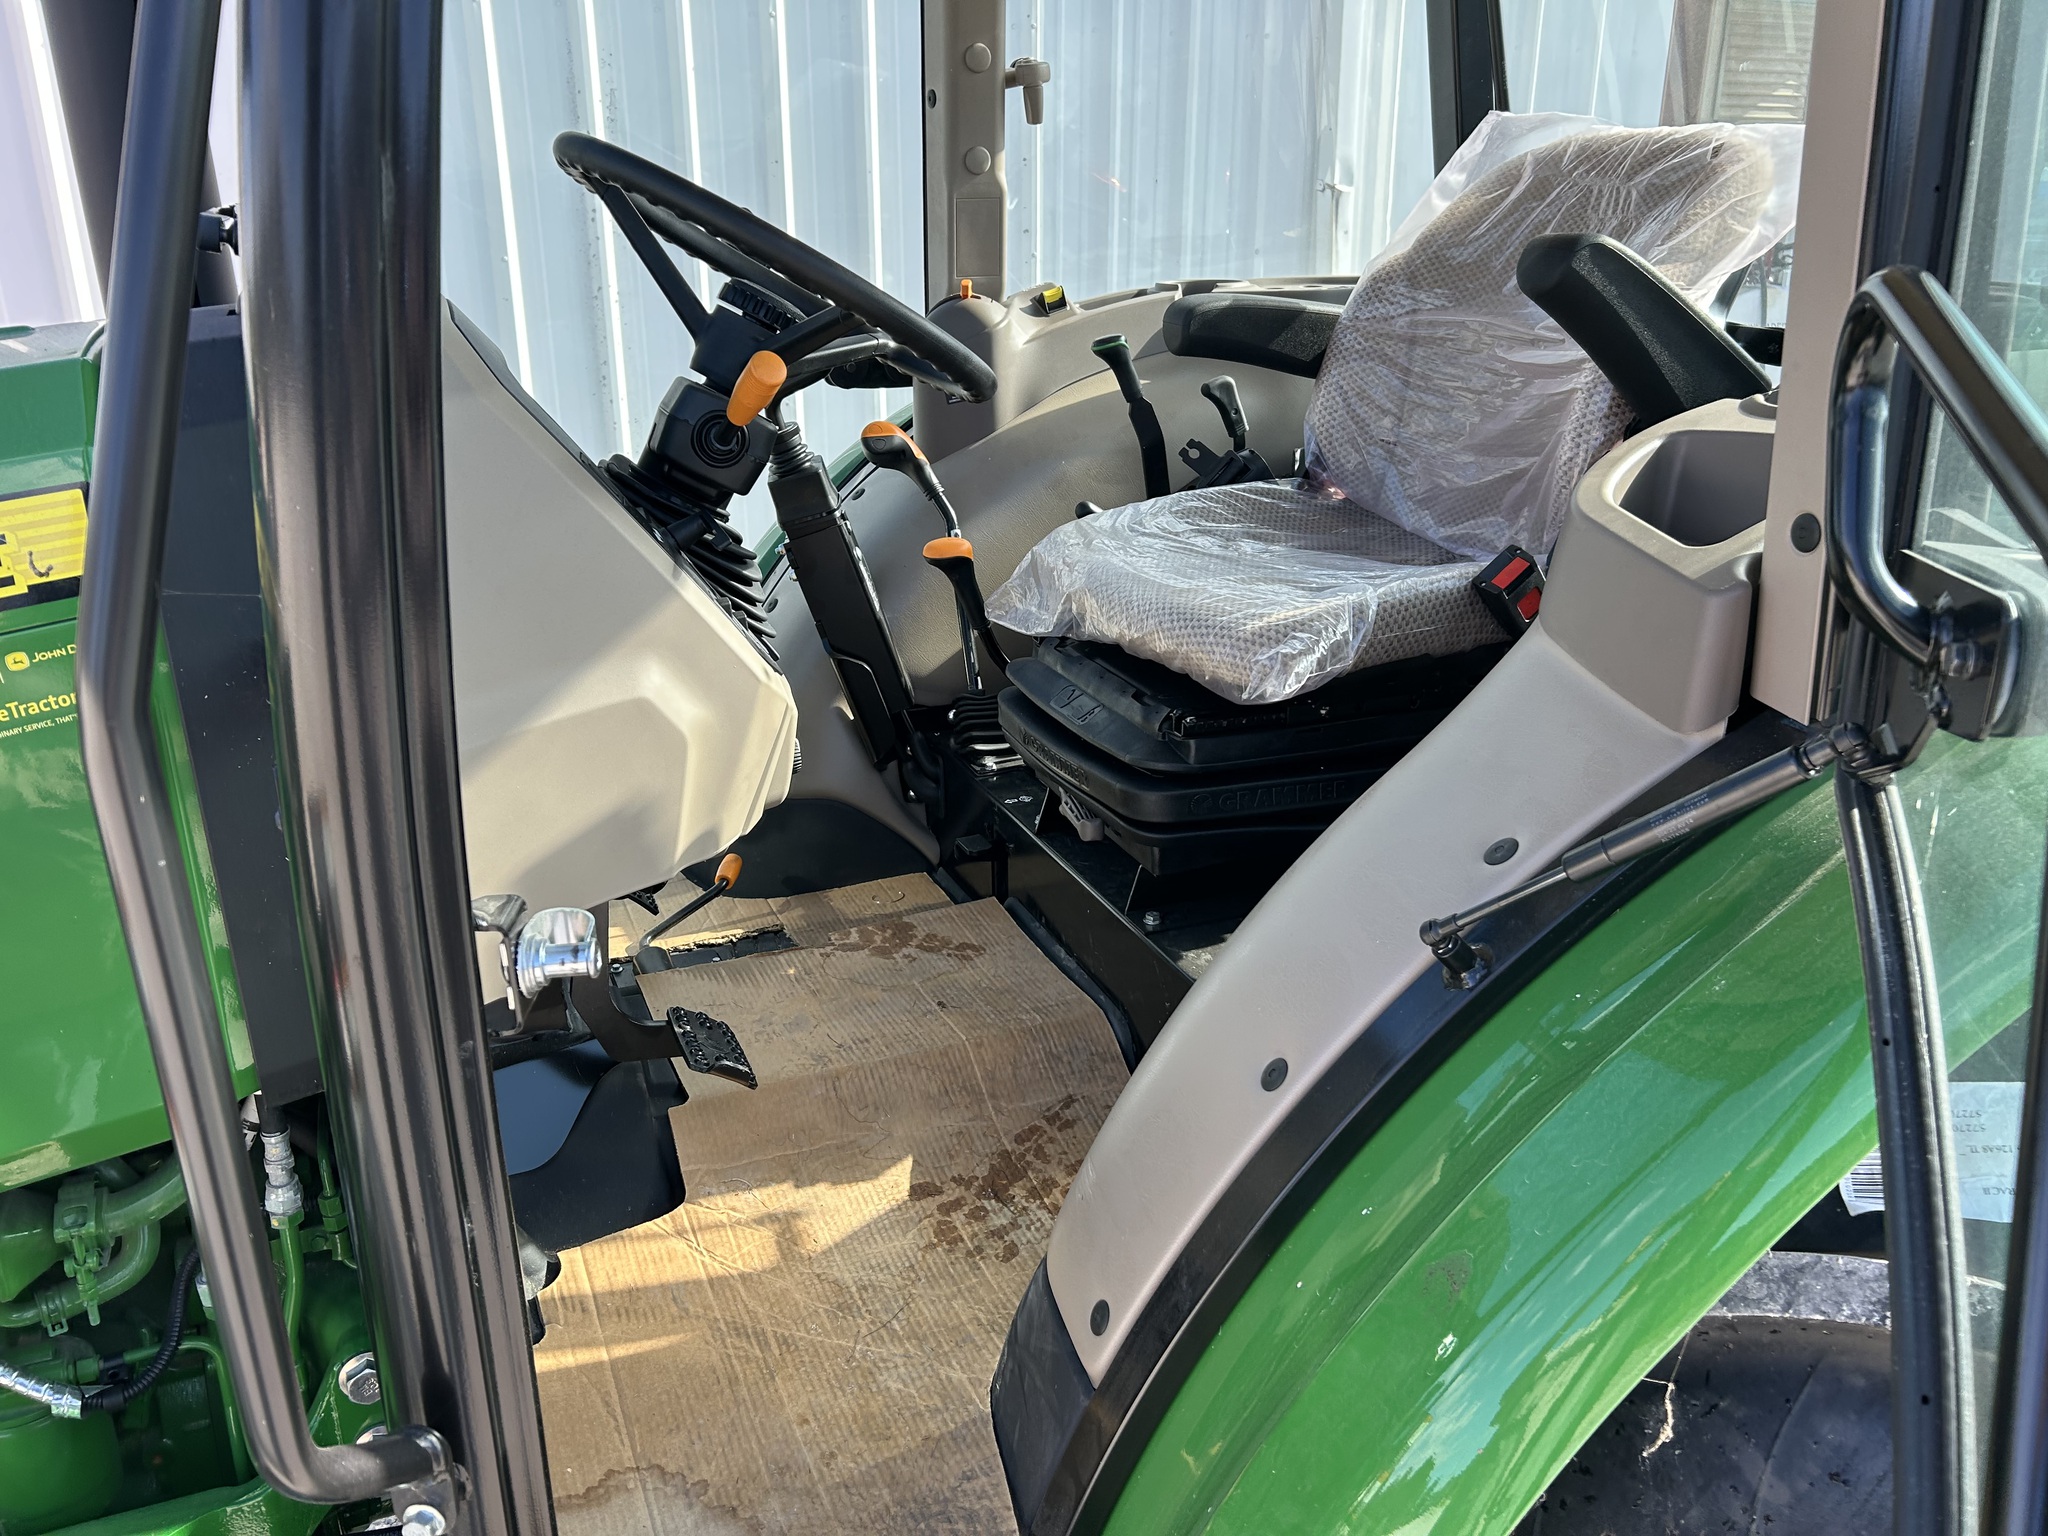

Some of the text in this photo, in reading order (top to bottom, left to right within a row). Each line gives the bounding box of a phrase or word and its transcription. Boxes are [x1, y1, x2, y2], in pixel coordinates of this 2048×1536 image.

[32, 648, 66, 662] JOHN
[23, 719, 55, 733] SERVICE,
[1218, 780, 1346, 812] GRAMMER
